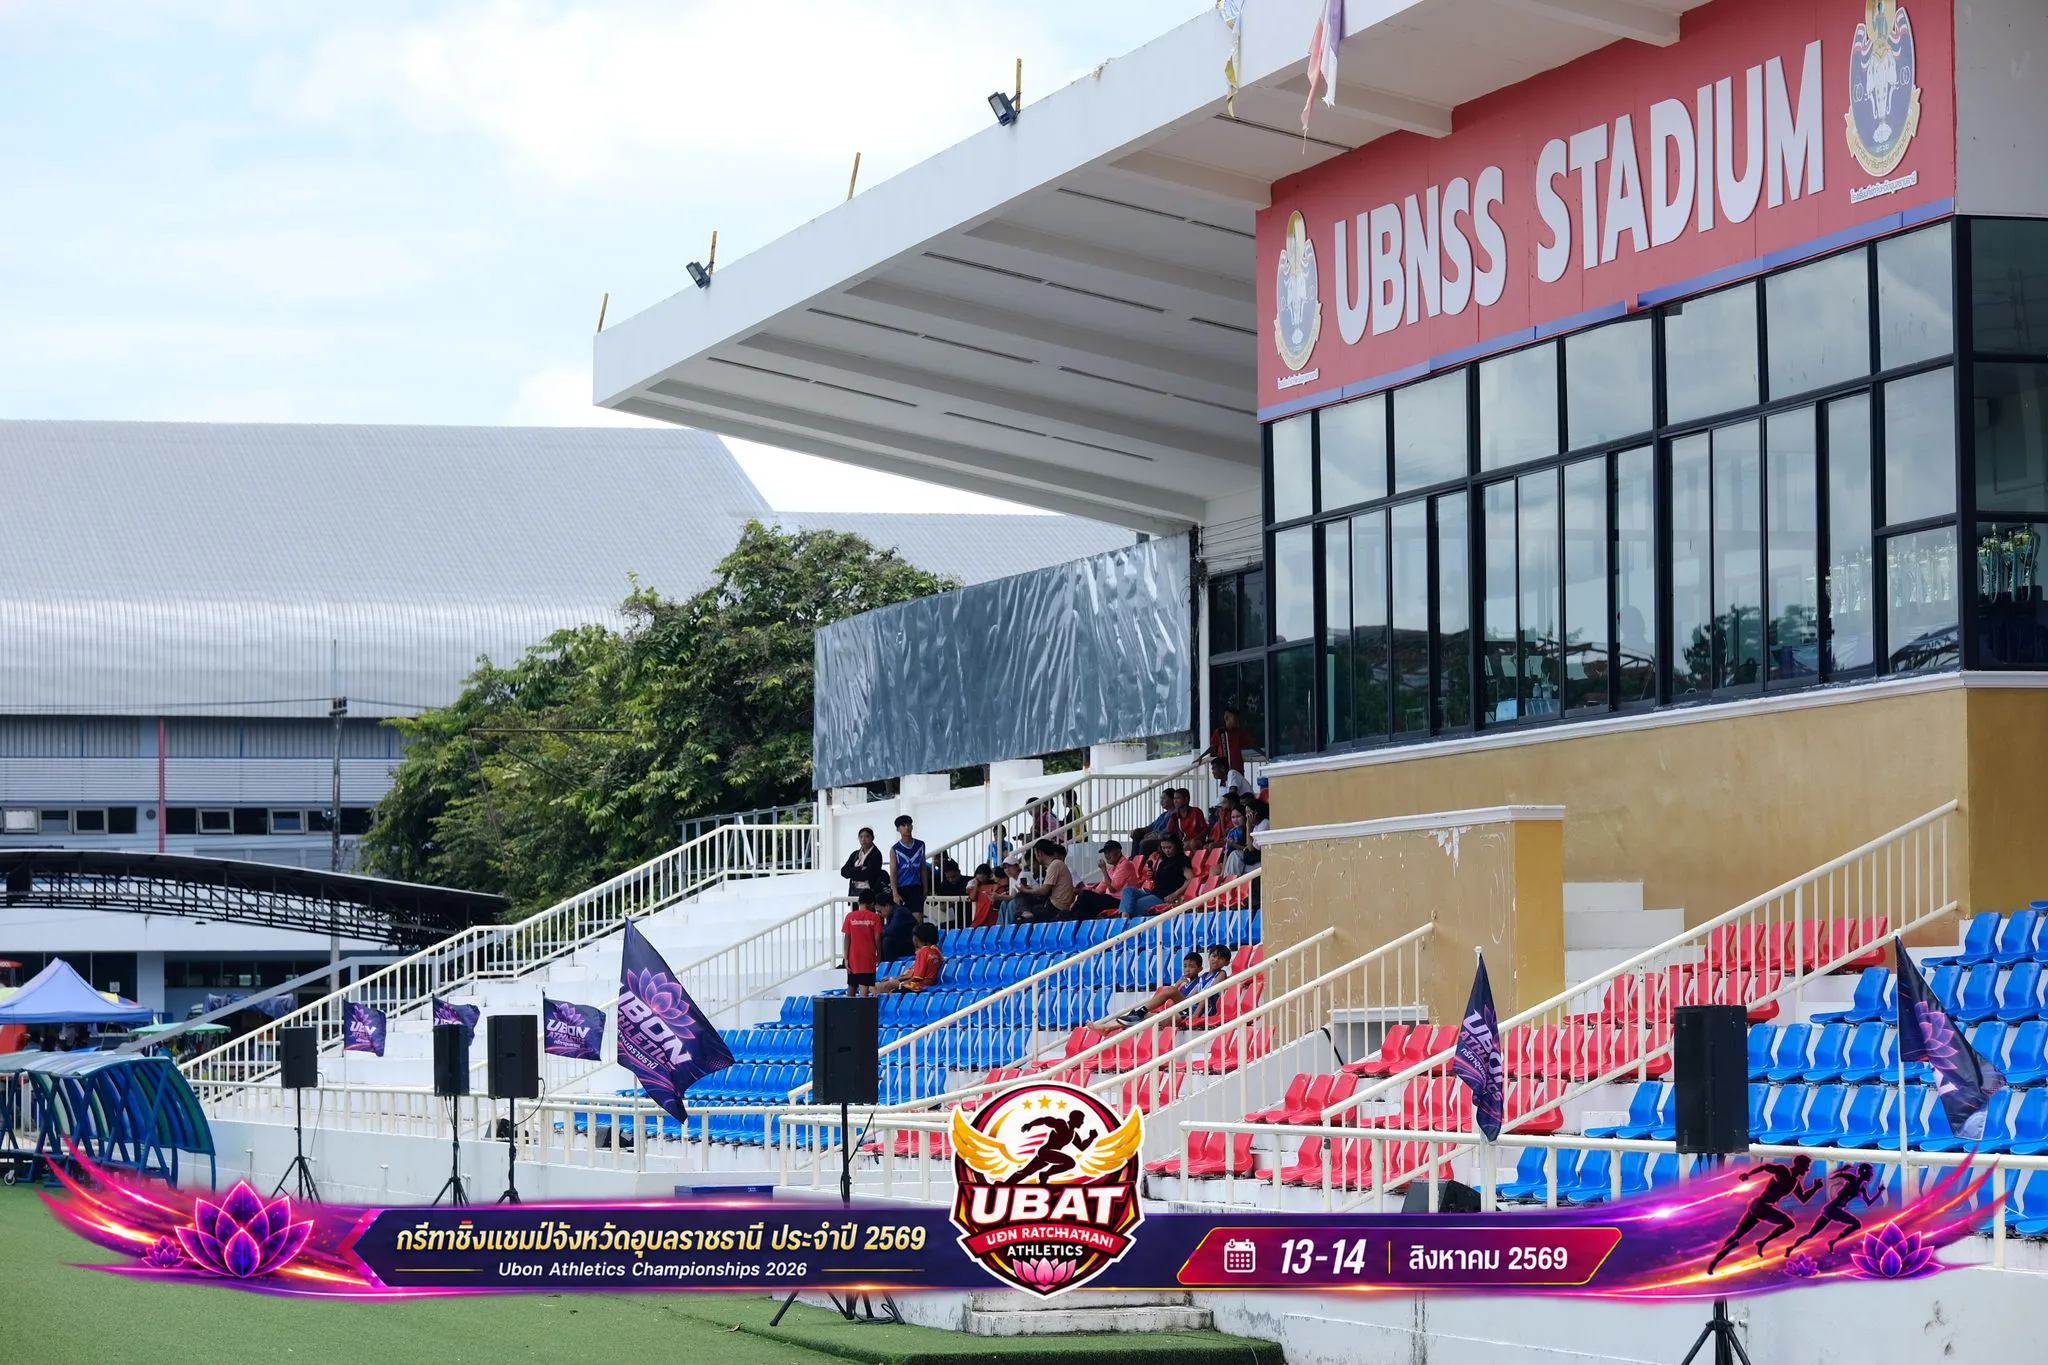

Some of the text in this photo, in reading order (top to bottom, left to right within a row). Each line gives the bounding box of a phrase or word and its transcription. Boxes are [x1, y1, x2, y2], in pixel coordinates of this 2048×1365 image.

[1334, 40, 1825, 345] UBNSS STADIUM
[546, 1018, 590, 1038] UBON
